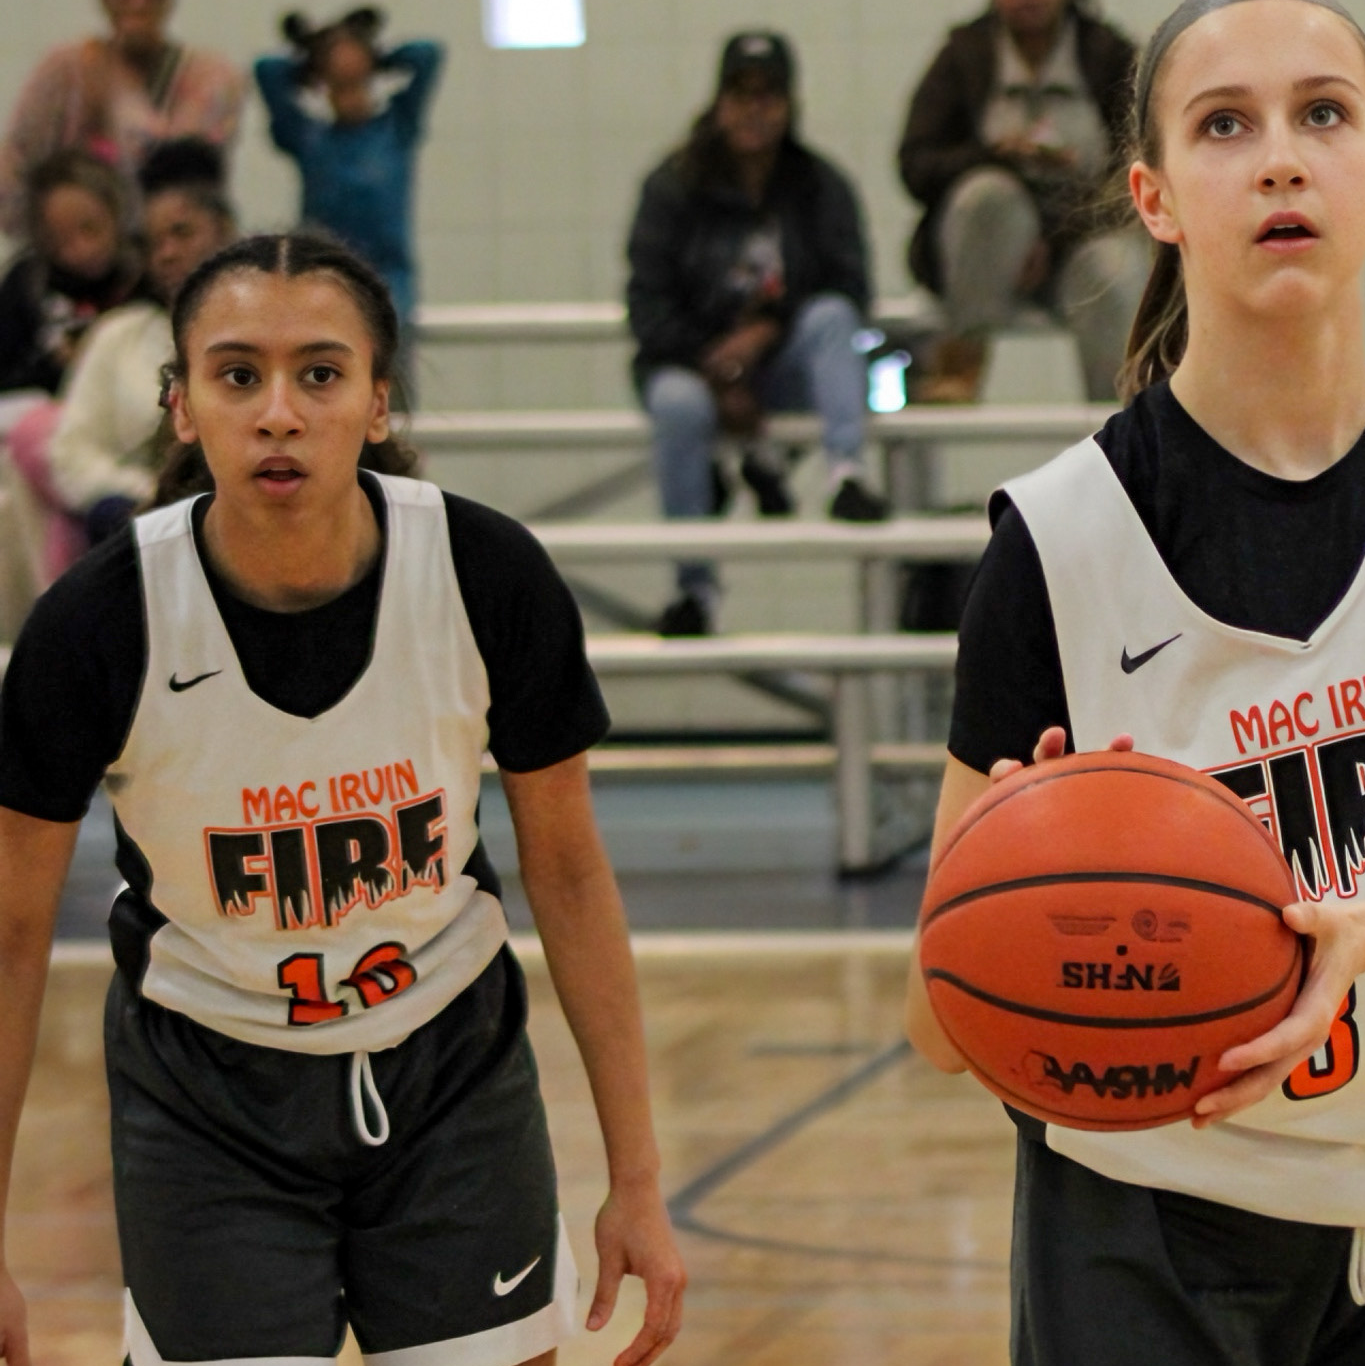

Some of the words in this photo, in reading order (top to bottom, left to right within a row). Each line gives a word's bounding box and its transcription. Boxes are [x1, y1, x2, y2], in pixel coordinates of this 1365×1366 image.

[1229, 691, 1320, 755] MAC
[241, 780, 320, 826] MAC
[328, 758, 420, 813] IRVIN
[203, 788, 449, 931] FIRE
[1061, 962, 1154, 992] NFHS
